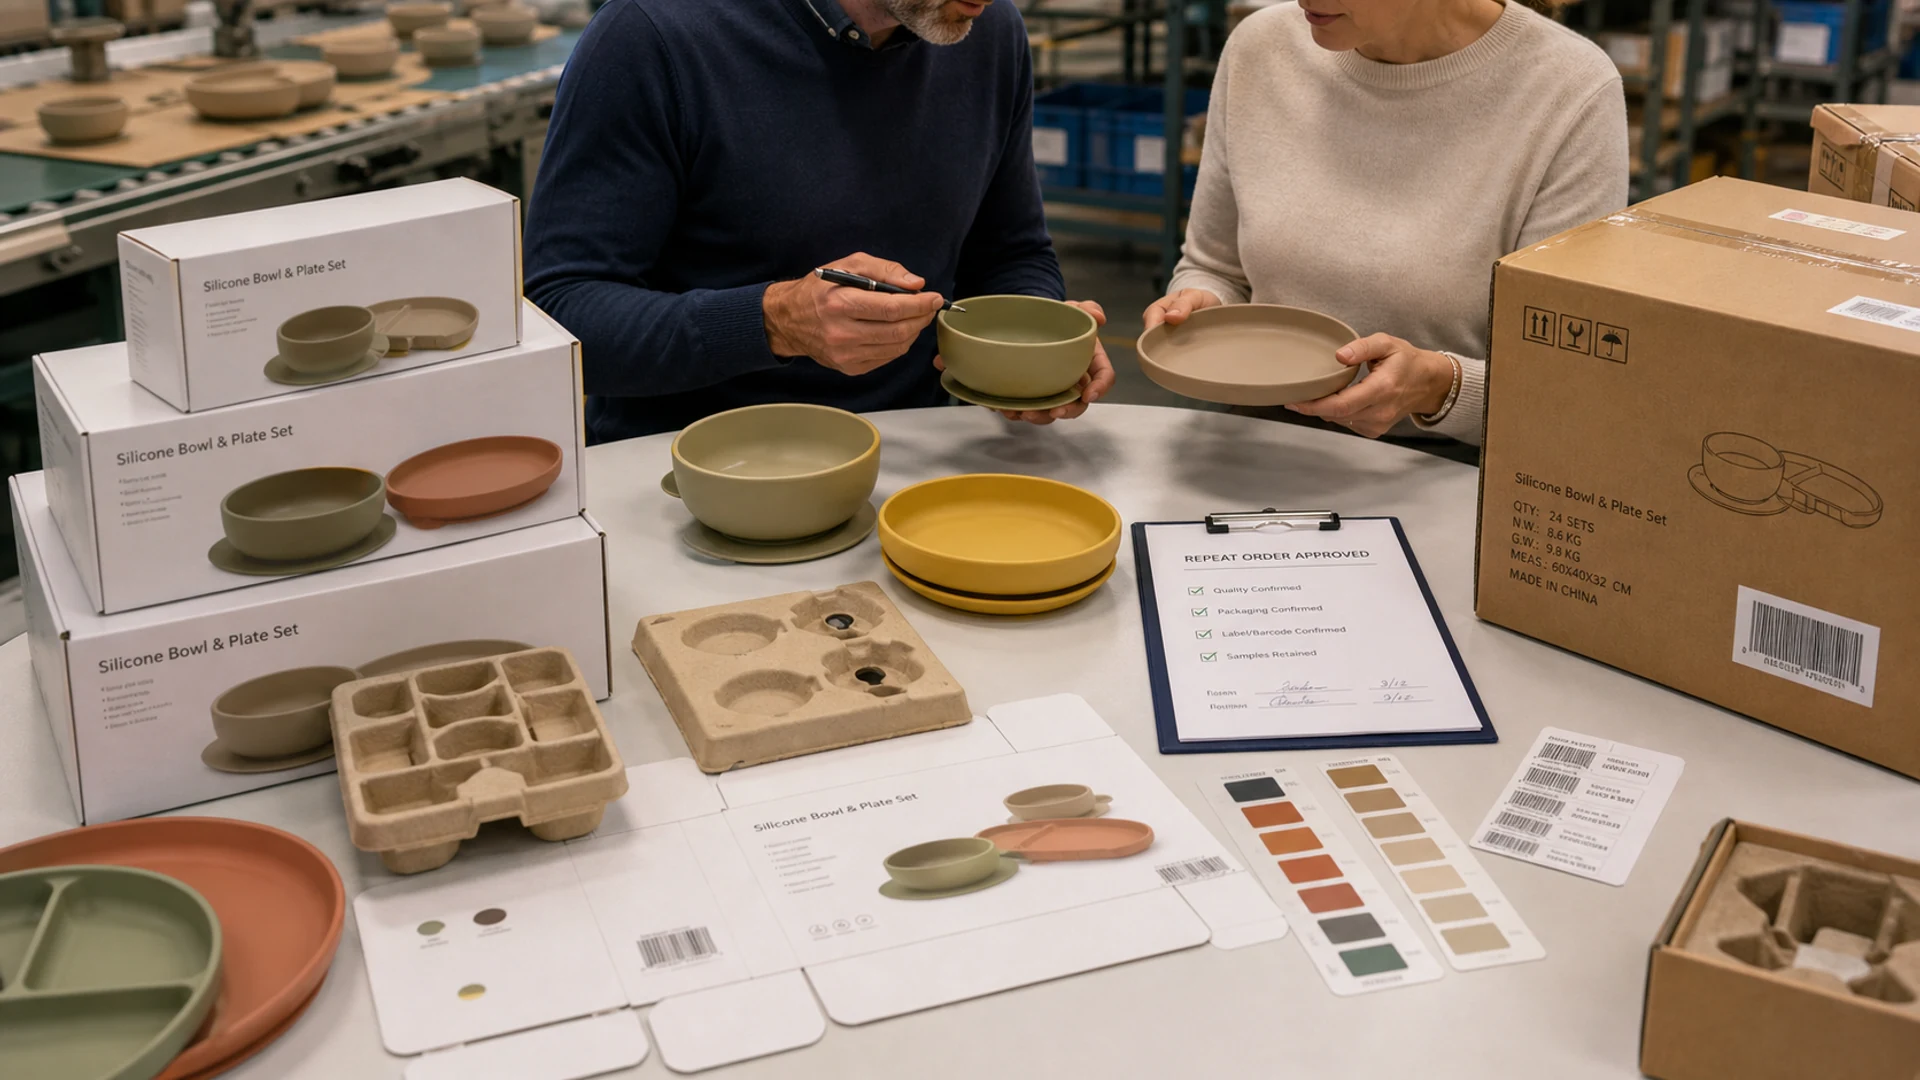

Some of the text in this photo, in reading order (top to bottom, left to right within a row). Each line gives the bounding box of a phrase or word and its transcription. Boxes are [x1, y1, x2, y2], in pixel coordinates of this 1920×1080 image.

[203, 259, 347, 293] Silicone Bowl & Plate Set
[117, 424, 293, 466] Silicone Bowl & Plate Set
[1515, 472, 1667, 526] Silicone Bowl & Plate Set
[1512, 517, 1582, 547] N.W.: 8.6 KG
[1513, 500, 1595, 533] QTY: 24 SETS
[1184, 550, 1370, 563] REPEAT ORDER APPROVED
[1511, 532, 1581, 563] G.W.: 9.8 KG
[1213, 585, 1302, 595] Quality Confirmed
[1509, 568, 1598, 606] MADE IN CHINA
[1218, 605, 1323, 615] Packaging Confirmed
[1222, 626, 1346, 638] Label/Barcode Confirmed
[99, 623, 299, 674] Silicone Bowl & Plate Set
[1226, 650, 1317, 661] Samples Retained
[753, 792, 919, 833] Silicone Bowl & Plate Set
